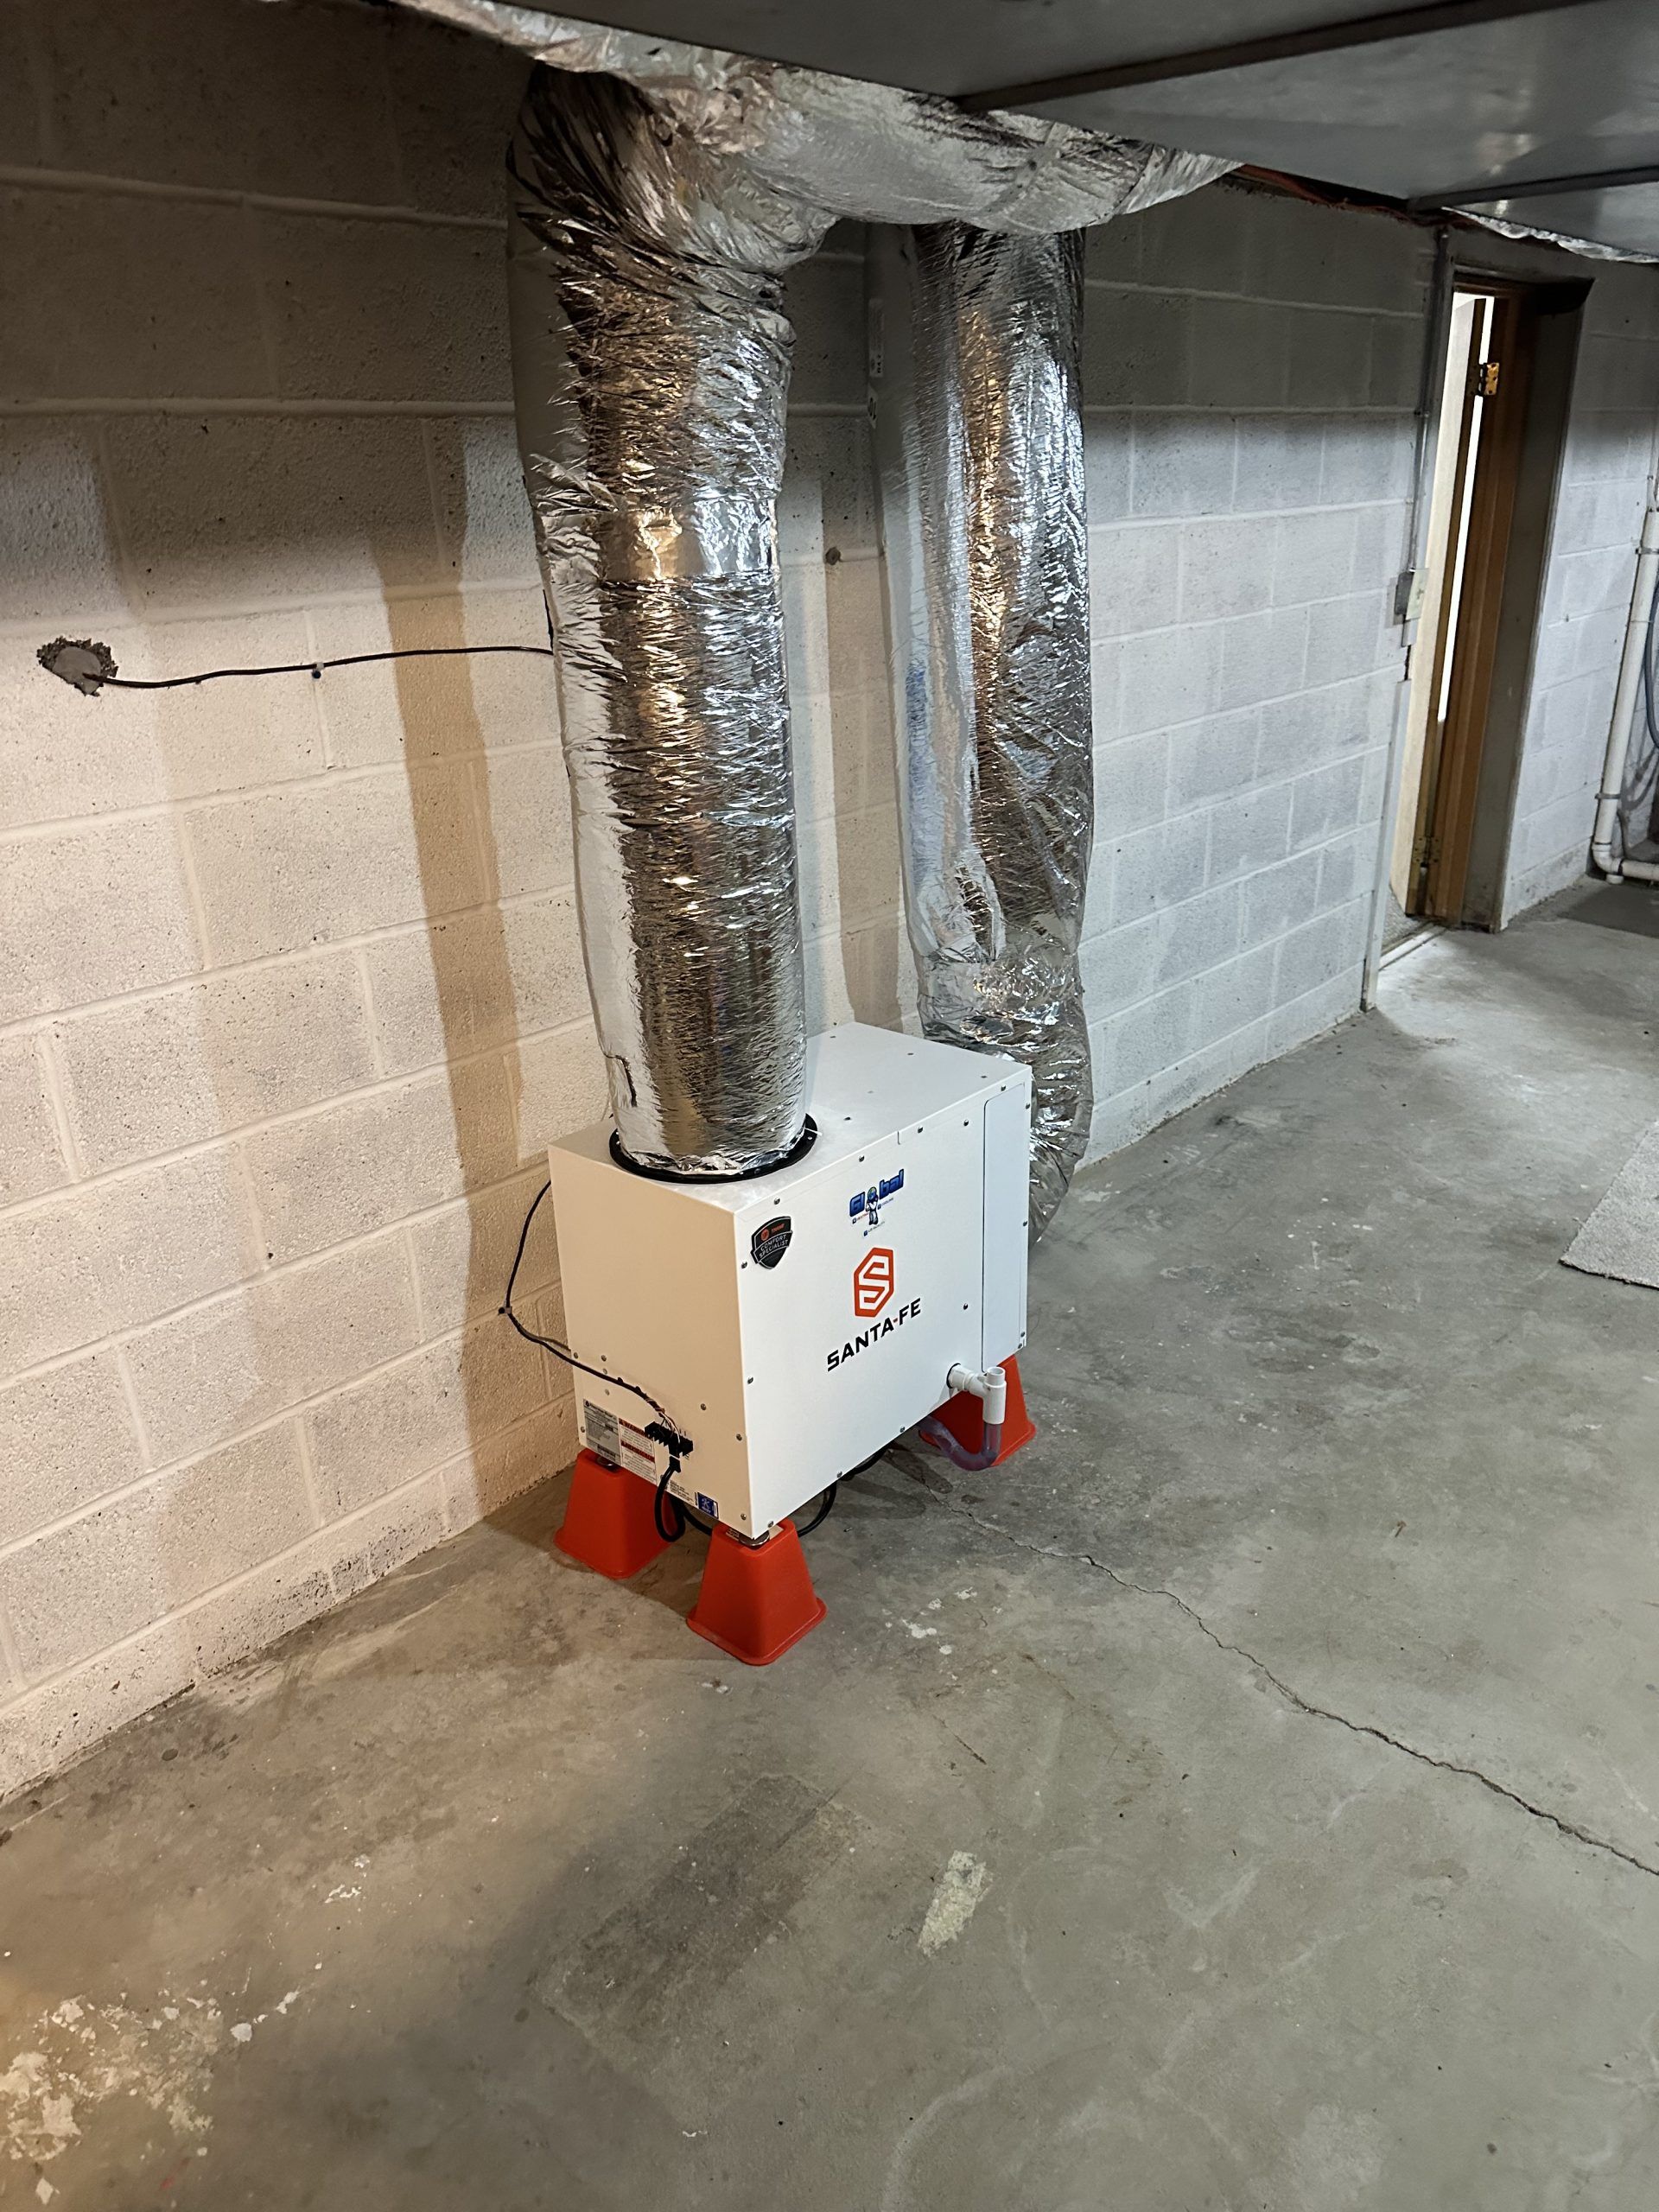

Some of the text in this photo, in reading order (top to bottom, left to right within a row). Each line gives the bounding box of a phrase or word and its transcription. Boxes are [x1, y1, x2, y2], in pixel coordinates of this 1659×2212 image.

[759, 1239, 788, 1258] SPECIALIST
[760, 1234, 786, 1251] COMFORT
[827, 1297, 921, 1372] SANTA-FE
